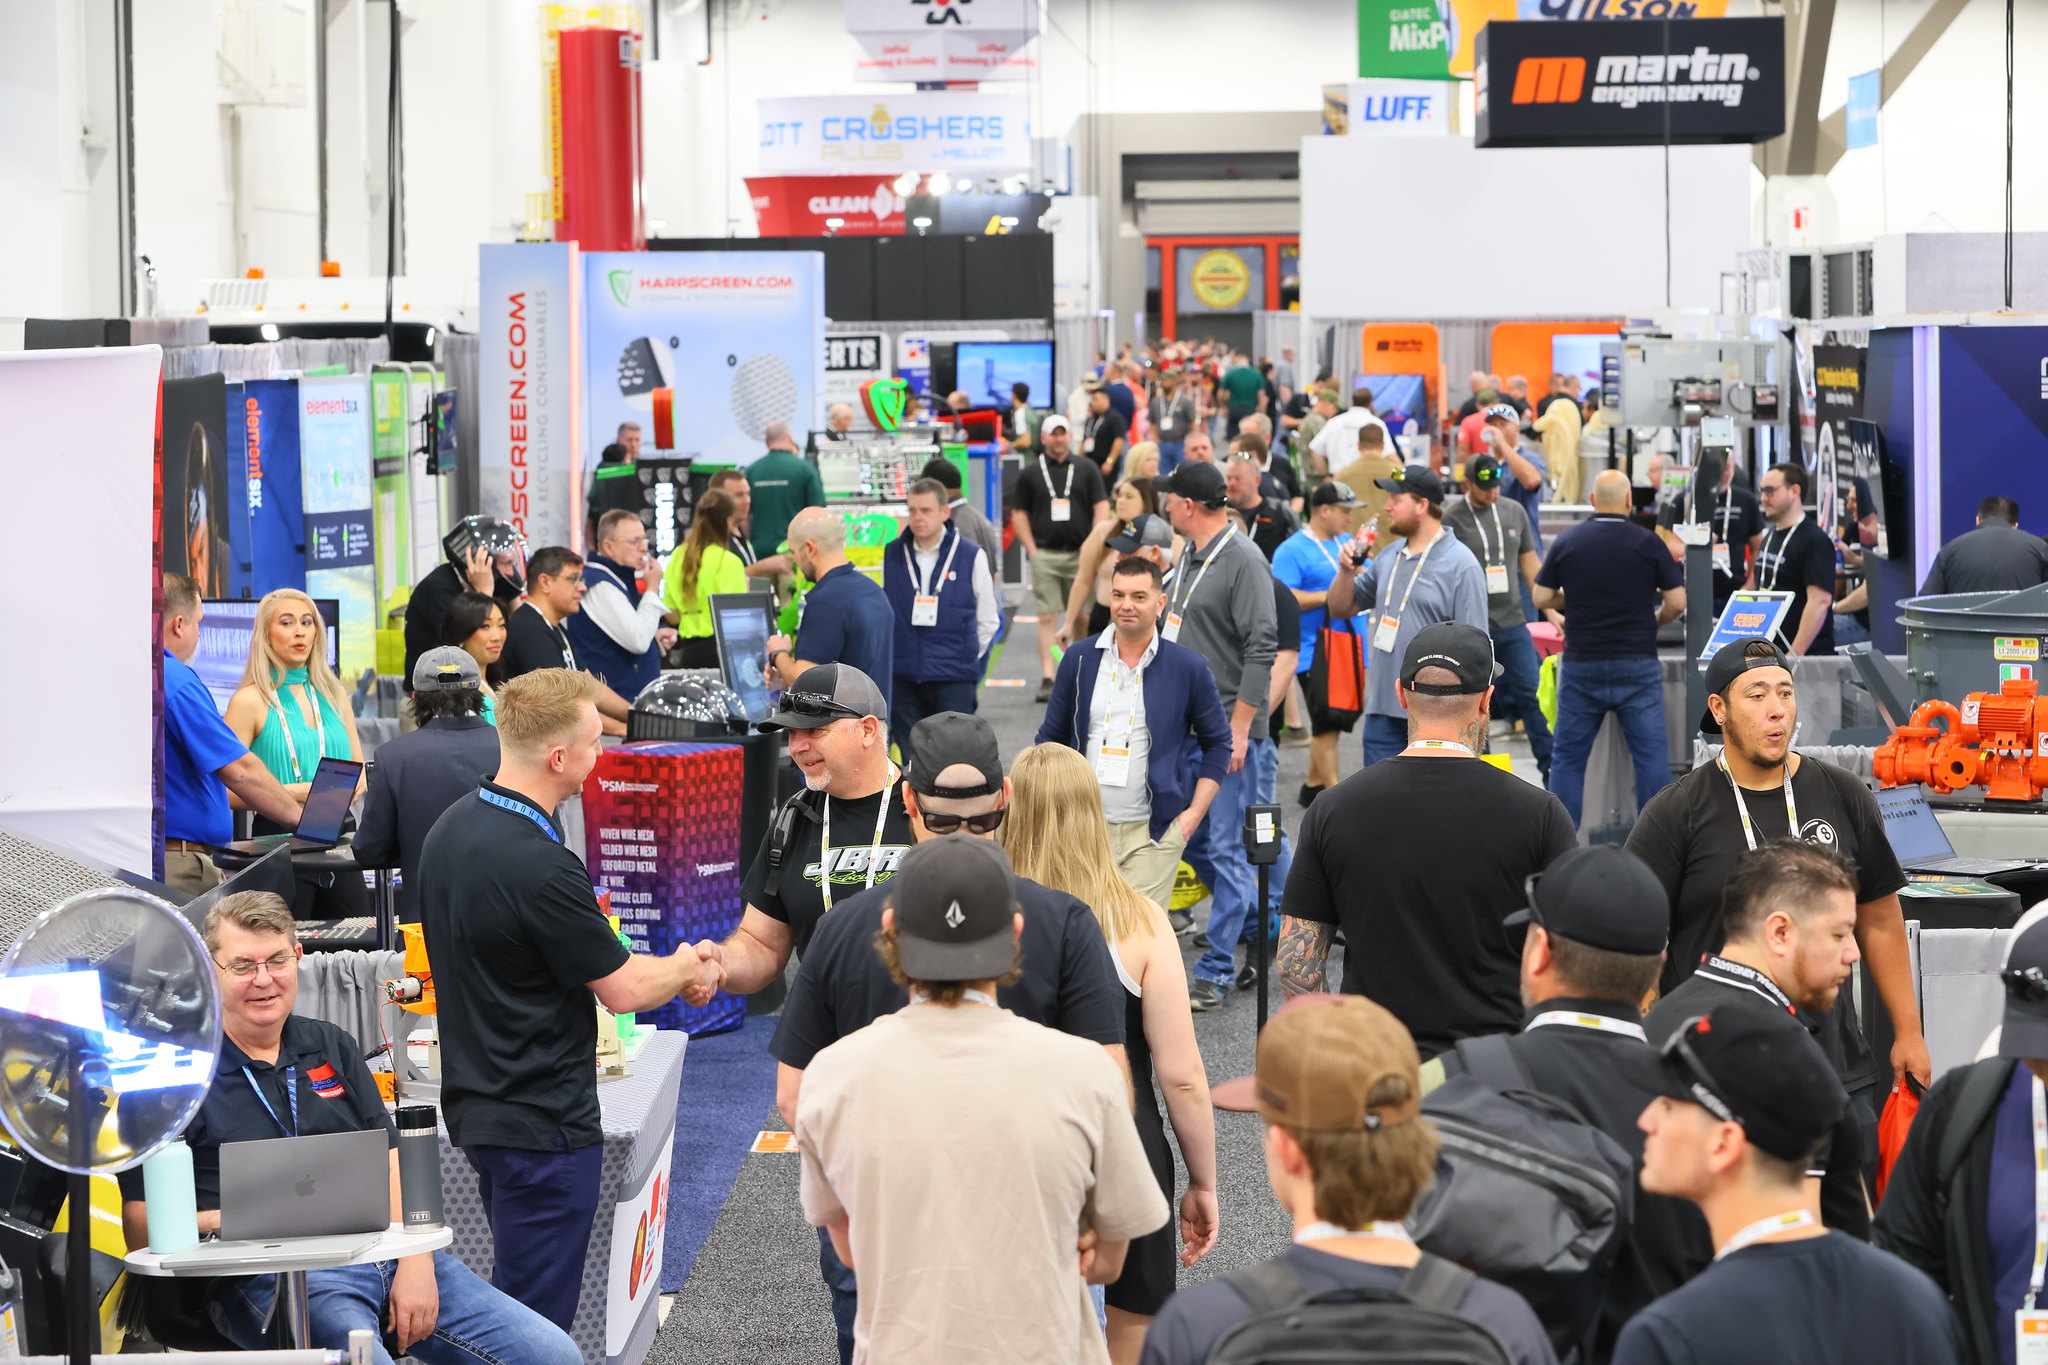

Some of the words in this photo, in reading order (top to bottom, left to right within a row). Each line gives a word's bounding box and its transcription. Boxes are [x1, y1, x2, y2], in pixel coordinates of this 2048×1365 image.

[1595, 46, 1749, 83] martin
[1591, 83, 1743, 108] engineering
[1365, 96, 1430, 121] LUFF
[808, 196, 870, 214] CLEAN
[640, 276, 793, 289] HARPSCREEN.COM
[508, 291, 528, 540] PSCREEN.COM
[246, 397, 263, 509] elementsix
[601, 781, 625, 792] PSM
[489, 793, 541, 822] THUNDER
[600, 828, 620, 840] WOVEN
[621, 829, 637, 840] WIRE
[637, 829, 655, 841] MESH
[600, 844, 623, 856] WELDED
[624, 845, 639, 857] WIRE
[640, 845, 658, 857] MESH
[600, 860, 636, 872] PERFORATED
[637, 861, 657, 873] METAL
[802, 847, 912, 879] JBR
[610, 876, 625, 888] WIRE
[632, 893, 653, 904] CLOTH
[635, 908, 661, 920] GRATING
[621, 924, 648, 936] GRATING
[631, 940, 651, 952] METAL
[411, 1212, 428, 1220] YETI
